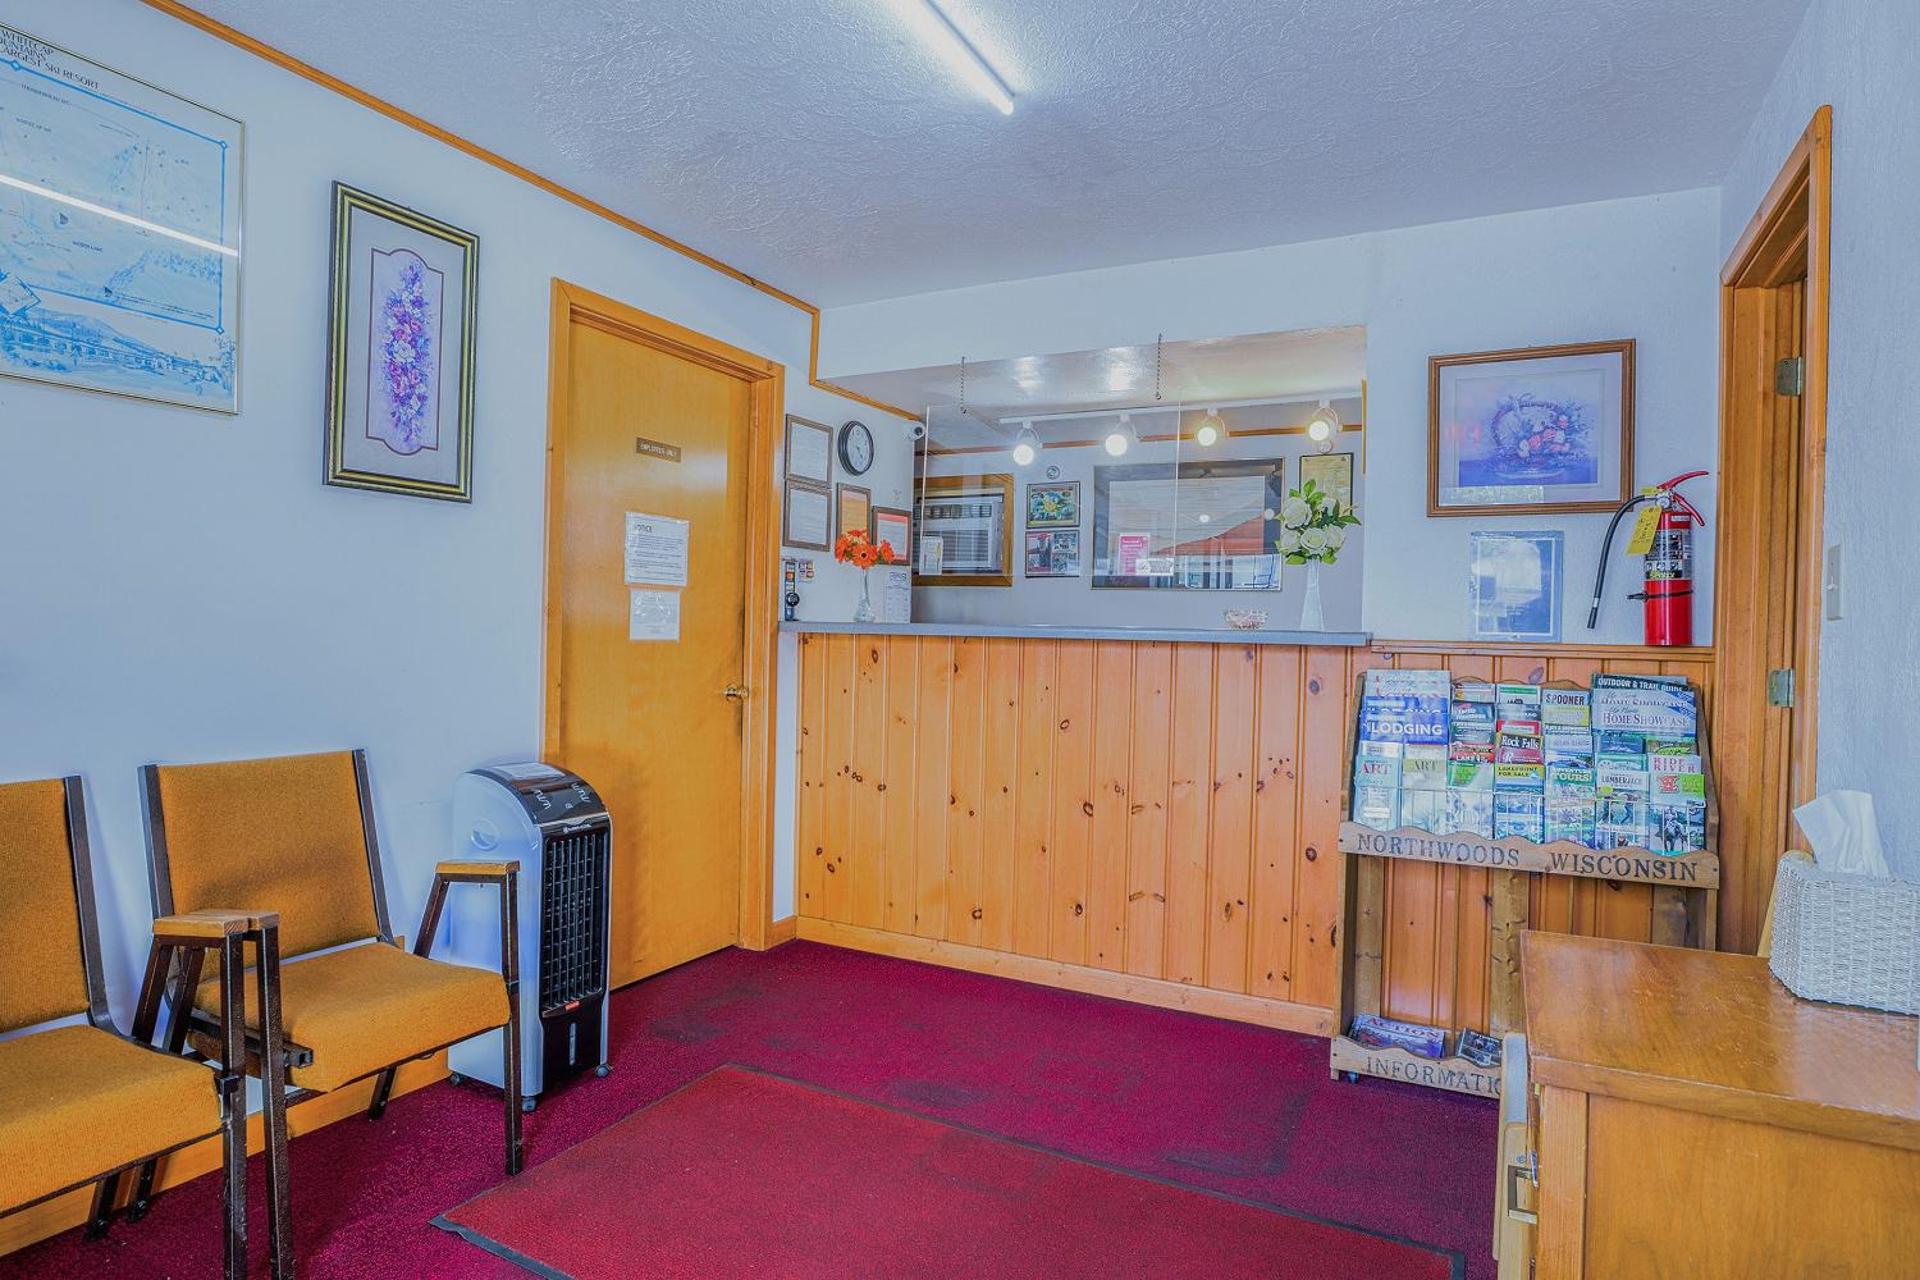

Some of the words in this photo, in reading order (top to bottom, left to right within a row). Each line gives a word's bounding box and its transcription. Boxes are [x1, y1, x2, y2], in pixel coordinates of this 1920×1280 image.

[45, 62, 60, 73] SKI
[63, 69, 99, 89] RESORT
[1598, 678, 1630, 688] OUTDOOR
[1545, 693, 1585, 706] SPOONER
[1371, 721, 1443, 736] LODGING
[1502, 735, 1519, 748] Rock
[1361, 762, 1394, 776] ART
[1412, 759, 1438, 772] ART
[1358, 833, 1520, 867] NORTHWOODS
[1550, 852, 1698, 881] WISCONSIN
